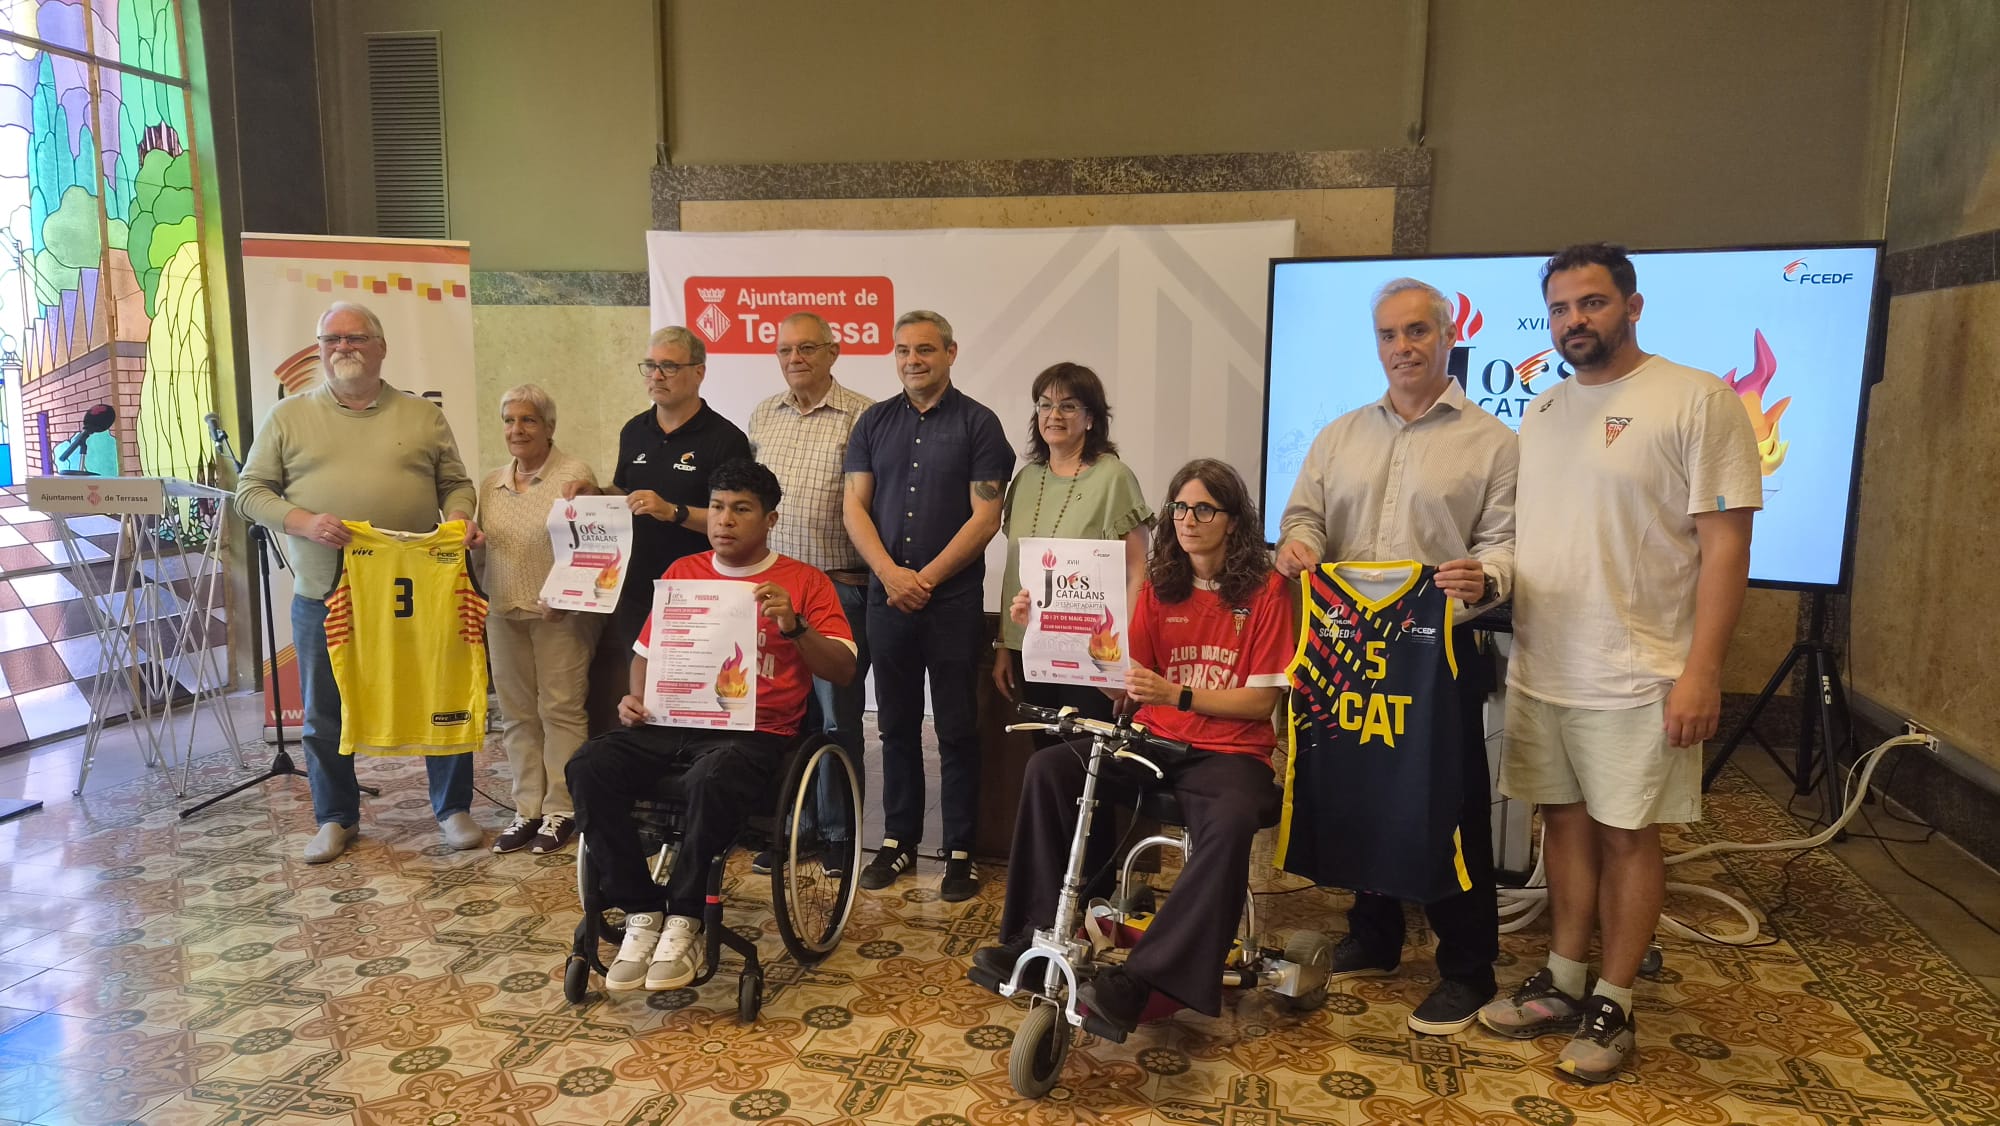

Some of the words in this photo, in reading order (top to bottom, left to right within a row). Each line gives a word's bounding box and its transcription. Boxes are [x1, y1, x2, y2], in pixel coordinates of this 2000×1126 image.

[1800, 273, 1854, 285] FCEDF
[737, 288, 847, 309] Ajuntament
[854, 288, 879, 306] de
[738, 314, 880, 344] Tessa
[1516, 317, 1549, 331] XVII
[41, 493, 84, 502] Ajuntament
[116, 494, 148, 502] Terrassa
[581, 534, 618, 542] CATALANS
[352, 546, 374, 556] vive
[393, 577, 413, 618] 3
[1056, 589, 1105, 600] CATALANS
[1411, 627, 1437, 635] FCEDF
[1366, 641, 1386, 680] 5
[1339, 691, 1412, 748] CAT
